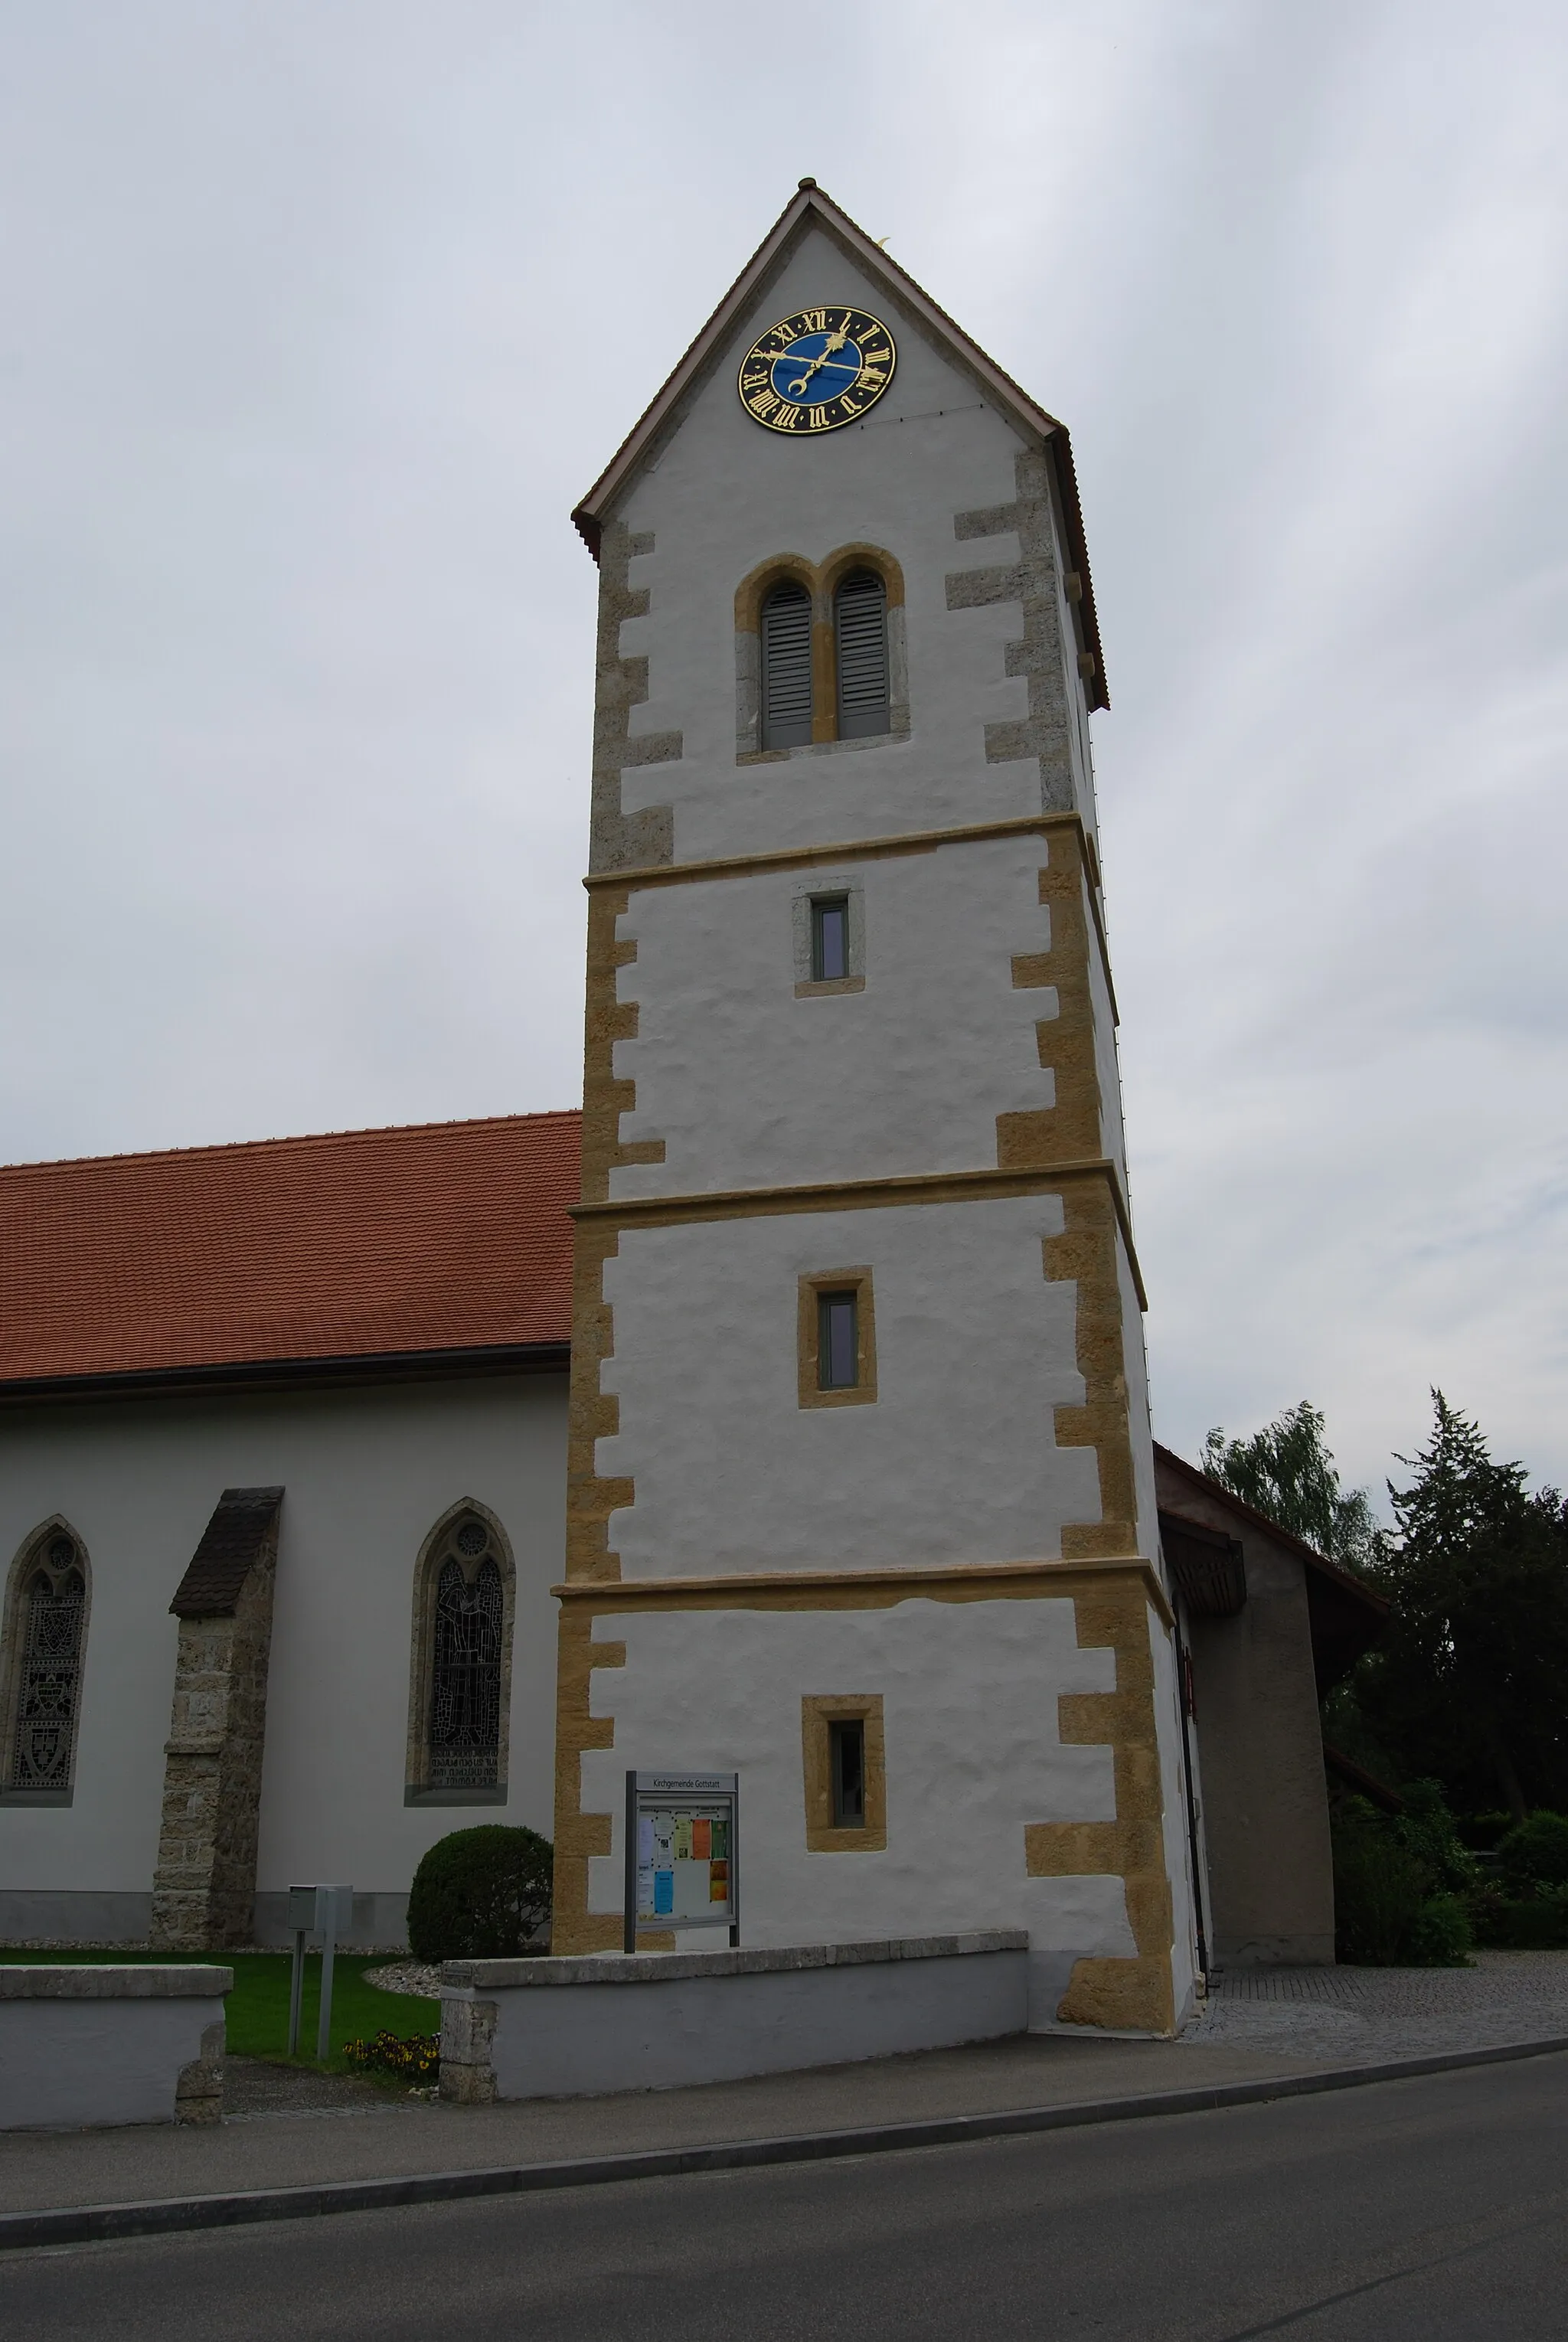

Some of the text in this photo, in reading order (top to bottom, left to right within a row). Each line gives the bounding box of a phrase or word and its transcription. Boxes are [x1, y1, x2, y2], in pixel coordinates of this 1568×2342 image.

[802, 310, 826, 334] XII
[771, 324, 798, 346] XI
[857, 324, 880, 344] II
[865, 347, 890, 364] III
[743, 370, 768, 390] IX
[840, 395, 863, 415] V
[653, 1779, 720, 1788] Kirchgemeinde Gottstatt
